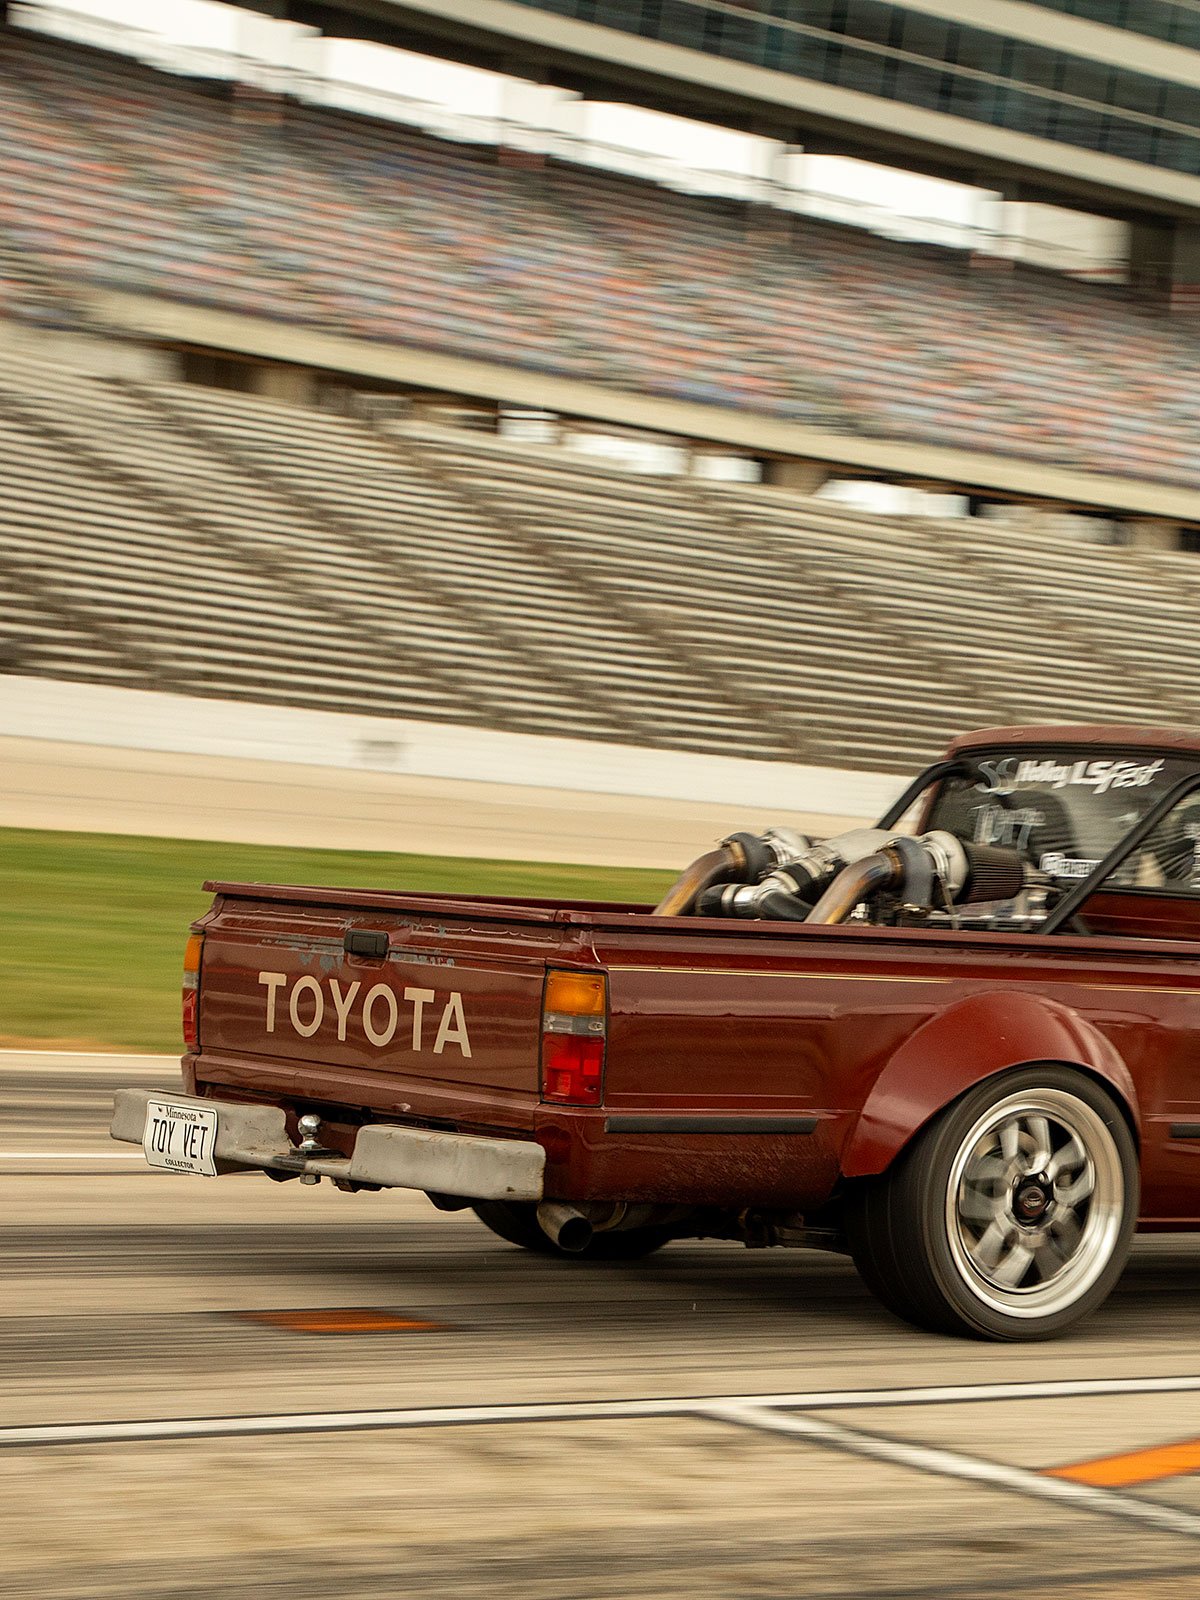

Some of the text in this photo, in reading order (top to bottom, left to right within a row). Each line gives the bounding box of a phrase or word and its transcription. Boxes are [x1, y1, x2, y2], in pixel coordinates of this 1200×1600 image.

[258, 972, 472, 1058] TOYOTA
[165, 1106, 197, 1121] Minnesota
[151, 1118, 208, 1160] TOY VET
[165, 1158, 195, 1169] COLLECTOR
